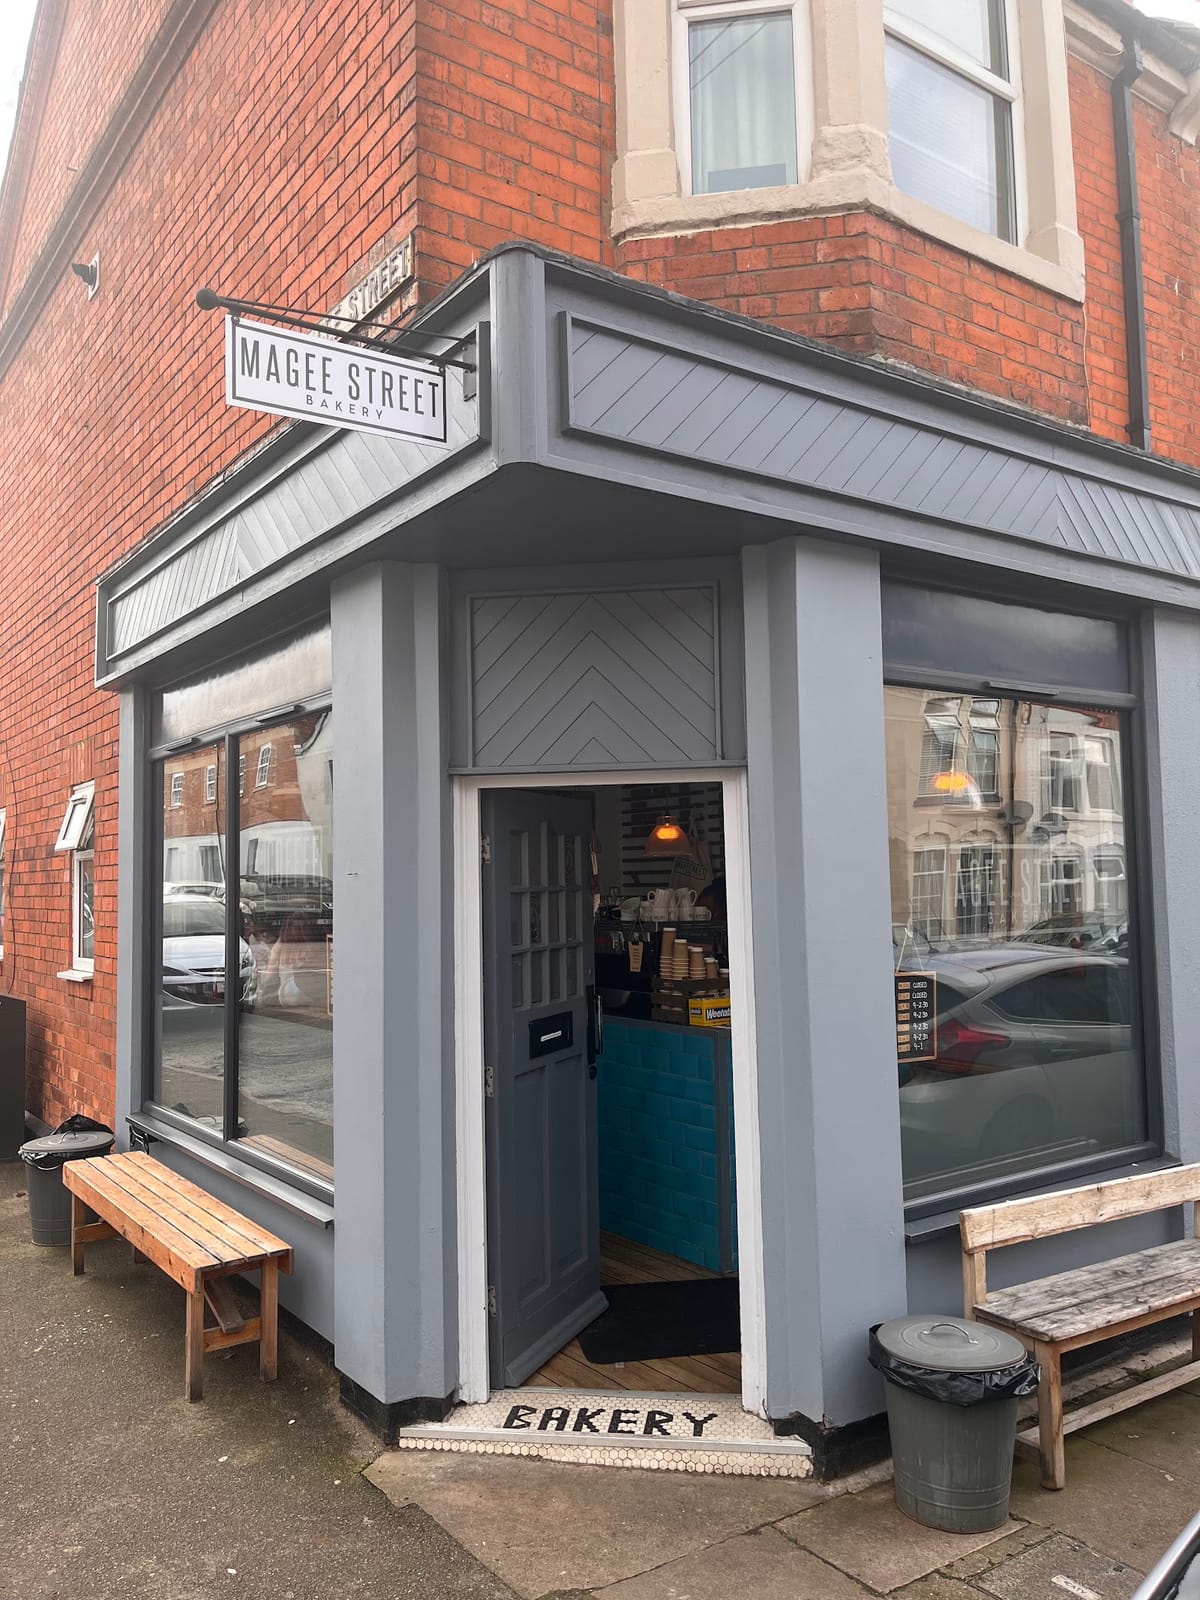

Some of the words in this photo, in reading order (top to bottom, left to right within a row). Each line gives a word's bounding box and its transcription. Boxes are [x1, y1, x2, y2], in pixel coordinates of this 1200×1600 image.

[347, 243, 409, 320] STREET
[240, 336, 333, 395] MAGEE
[348, 363, 439, 418] STREET
[306, 395, 383, 420] BAKERY
[911, 991, 928, 999] CLOSED
[913, 1042, 923, 1051] 9-1
[502, 1404, 718, 1437] BAKERY
